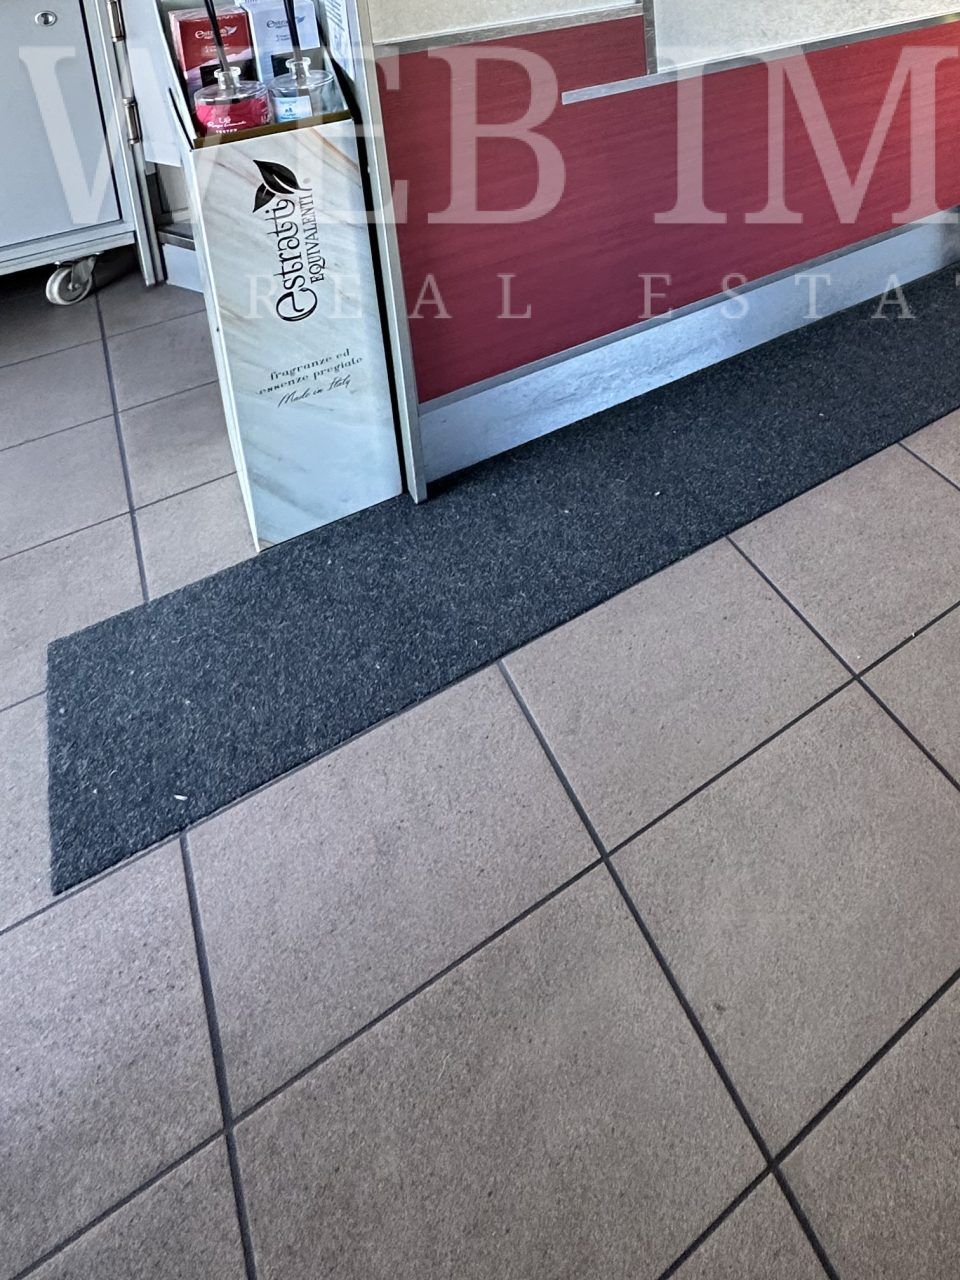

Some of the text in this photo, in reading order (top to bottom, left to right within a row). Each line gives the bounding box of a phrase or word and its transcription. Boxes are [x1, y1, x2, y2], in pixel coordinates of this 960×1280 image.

[299, 194, 327, 285] EQUIVALENTI
[265, 198, 318, 322] estratti
[269, 347, 351, 382] fragranze ed
[257, 373, 309, 396] essenze
[277, 374, 352, 409] Made in Italy
